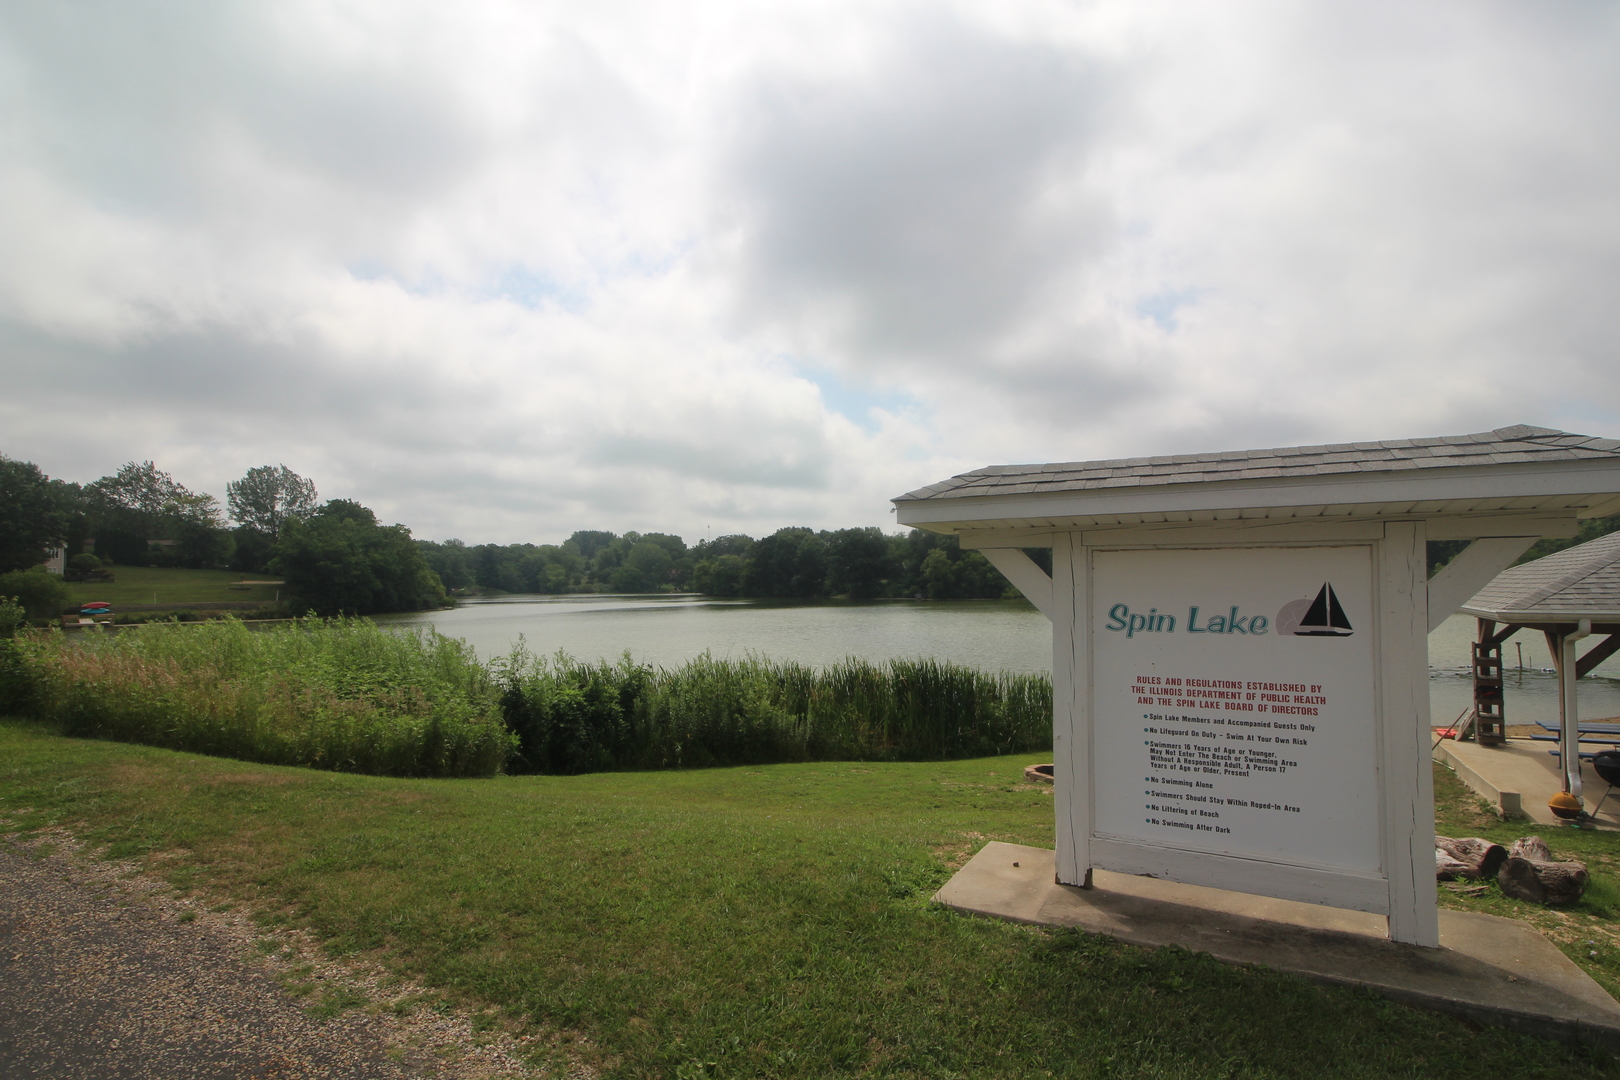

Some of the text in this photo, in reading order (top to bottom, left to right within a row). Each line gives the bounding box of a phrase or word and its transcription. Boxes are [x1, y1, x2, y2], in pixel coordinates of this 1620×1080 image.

[1105, 603, 1268, 639] Spin Lake
[1136, 676, 1322, 693] RULES AND REGULATIONS ESTABLISHED BY
[1131, 686, 1326, 705] THE ILLINOIS DEPARTMENT OF PUBLIC HEALTH
[1138, 696, 1319, 716] AND THE SPIN LAKE BOARD OF DIRECTORS
[1182, 716, 1210, 724] Members
[1227, 719, 1271, 728] Accompanied
[1300, 724, 1315, 732] Only
[1160, 728, 1189, 737] Lifeguard
[1202, 731, 1217, 739] Duty
[1150, 741, 1182, 749] Swimmers
[1223, 747, 1236, 755] Age
[1184, 758, 1221, 767] Responsible
[1253, 764, 1277, 772] Person
[1212, 753, 1232, 761] Beach
[1244, 756, 1278, 766] Swimming
[1224, 769, 1249, 777] Present
[1161, 778, 1193, 787] Swimming
[1151, 790, 1183, 800] Swimmers
[1186, 794, 1206, 802] Should
[1227, 799, 1248, 807] Within
[1250, 801, 1282, 811] Roped-In
[1284, 804, 1300, 812] Area
[1162, 806, 1188, 815] Littering
[1200, 810, 1219, 818] Beach
[1162, 819, 1194, 830] Swimming
